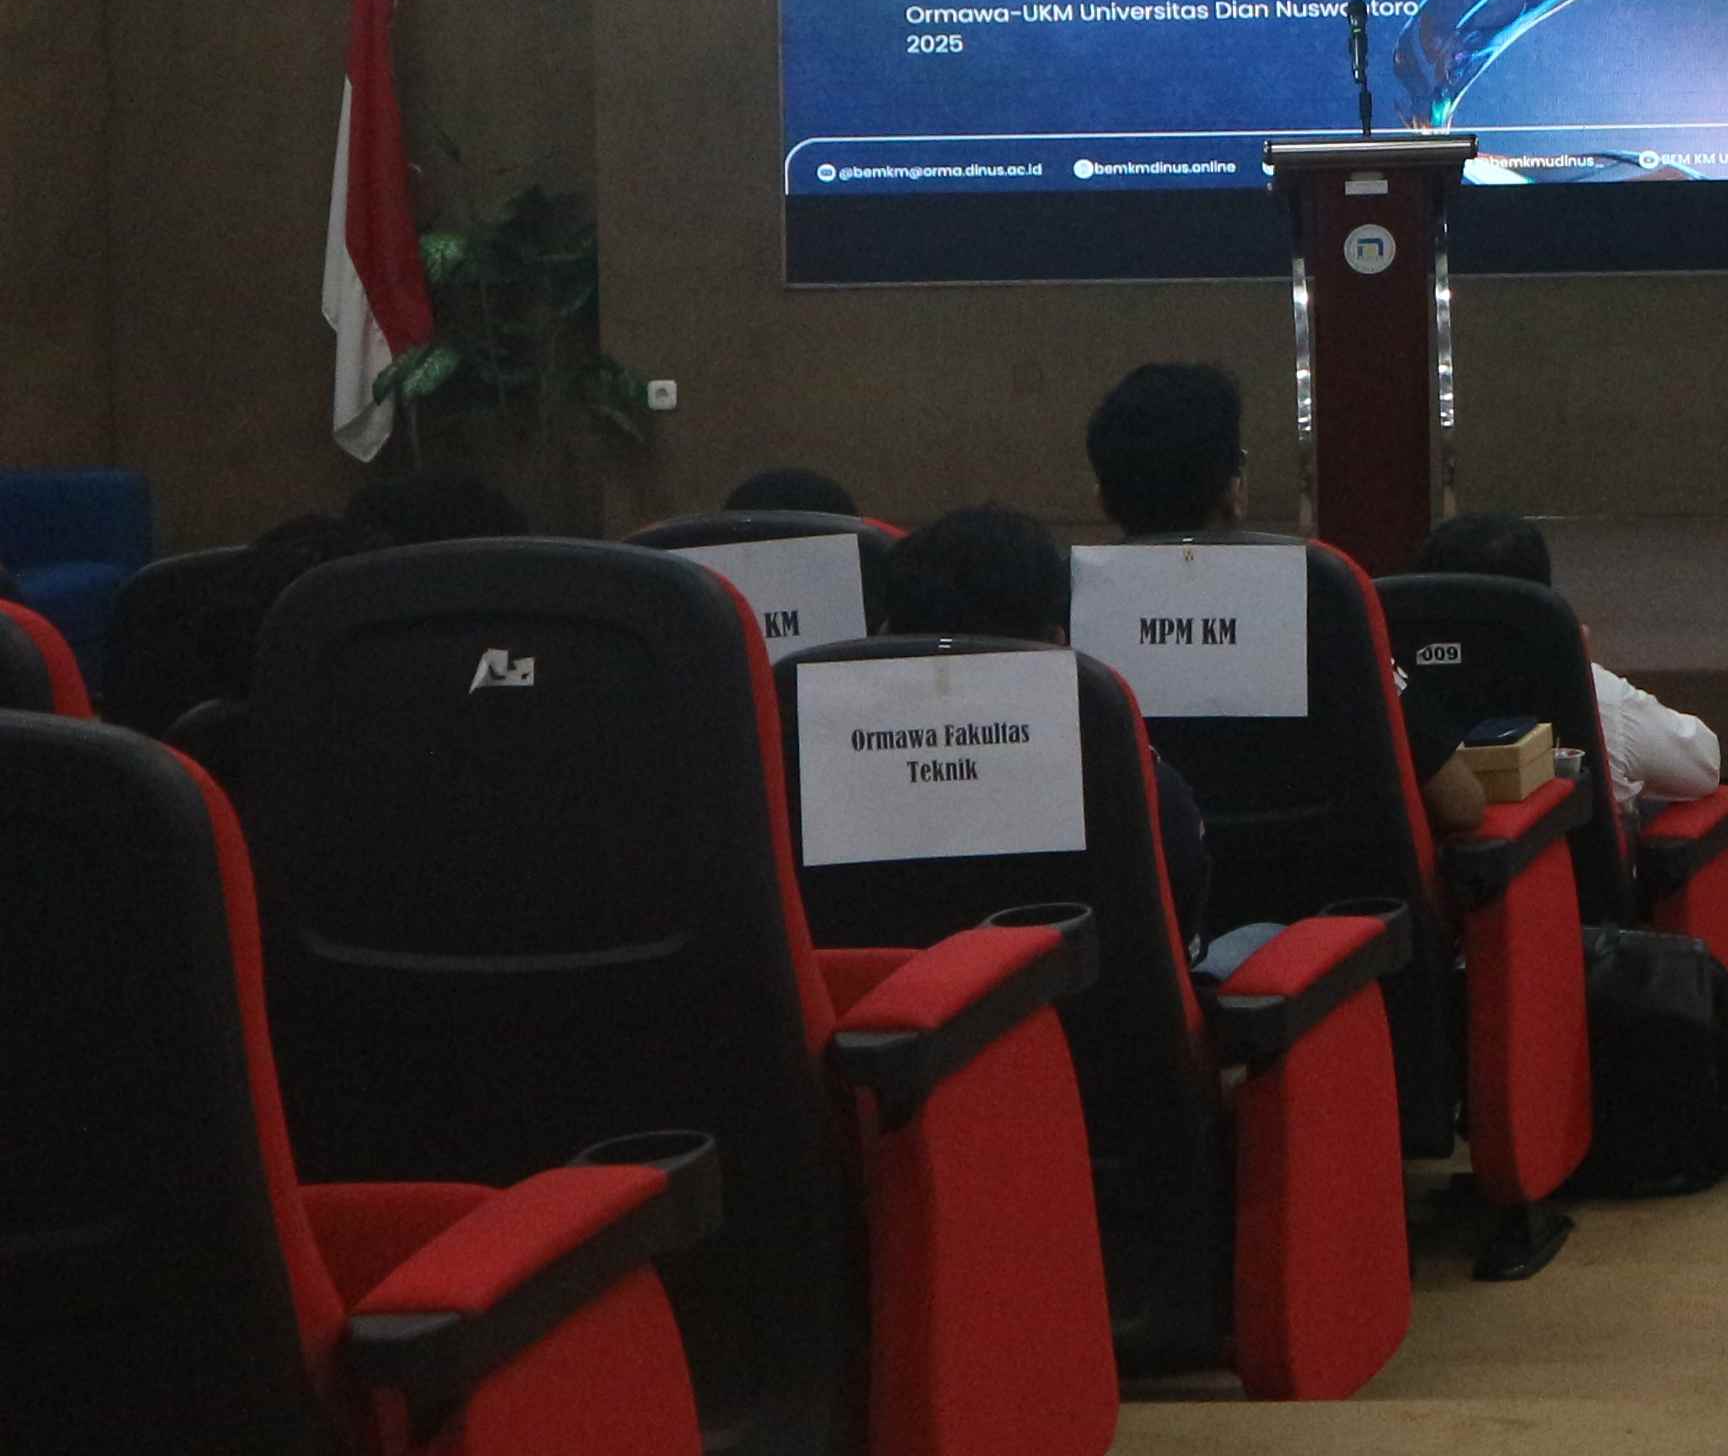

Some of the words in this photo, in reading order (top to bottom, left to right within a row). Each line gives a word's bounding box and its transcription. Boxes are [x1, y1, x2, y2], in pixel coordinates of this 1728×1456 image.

[906, 3, 1073, 25] Ormawa-UKM
[1080, 1, 1209, 22] Universitas
[1215, 0, 1269, 21] Dian
[1276, 0, 1419, 19] Nuswtoro
[906, 34, 964, 54] 2025
[1095, 160, 1236, 175] bemkmdinus.online
[1693, 153, 1716, 164] KM
[838, 163, 1043, 181] @bemkm@orma.dinus.ac.id
[764, 610, 800, 638] KM
[1140, 617, 1193, 644] MPM
[1201, 617, 1237, 644] KM
[1422, 646, 1458, 661] 009
[851, 727, 937, 752] Ormawa
[944, 722, 1030, 747] Fakultas
[907, 758, 979, 783] Teknik
